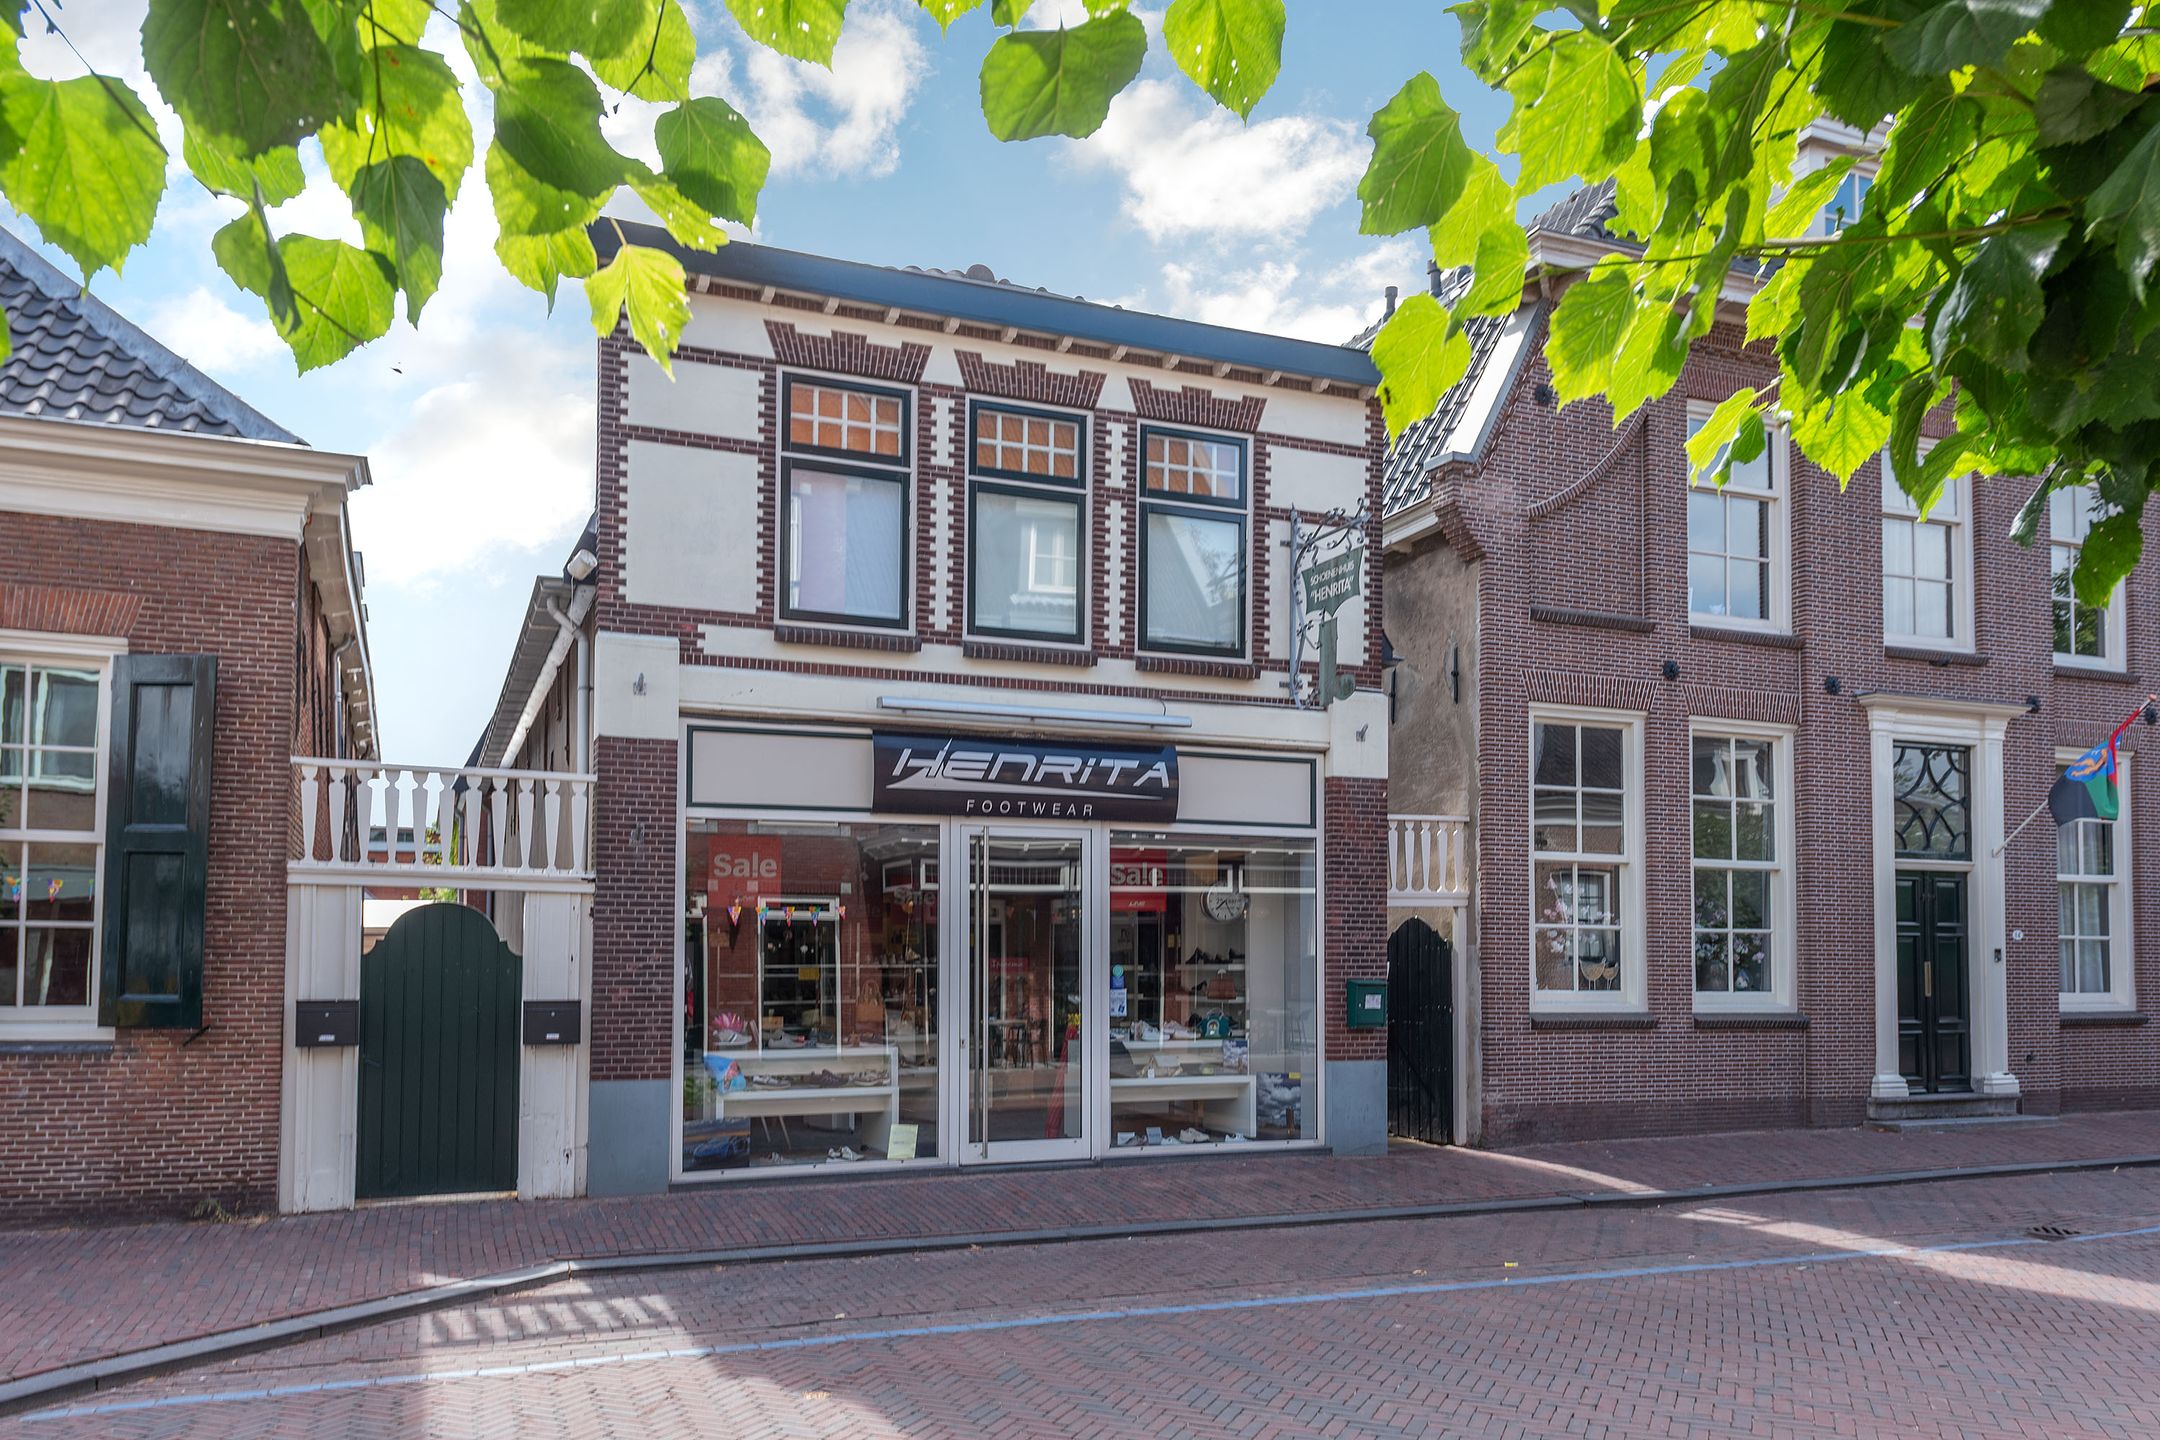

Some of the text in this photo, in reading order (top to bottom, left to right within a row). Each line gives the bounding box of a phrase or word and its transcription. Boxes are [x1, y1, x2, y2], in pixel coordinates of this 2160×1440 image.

[966, 800, 1093, 817] FOOTWEAR
[713, 851, 778, 878] Sale
[1110, 862, 1164, 885] Sale
